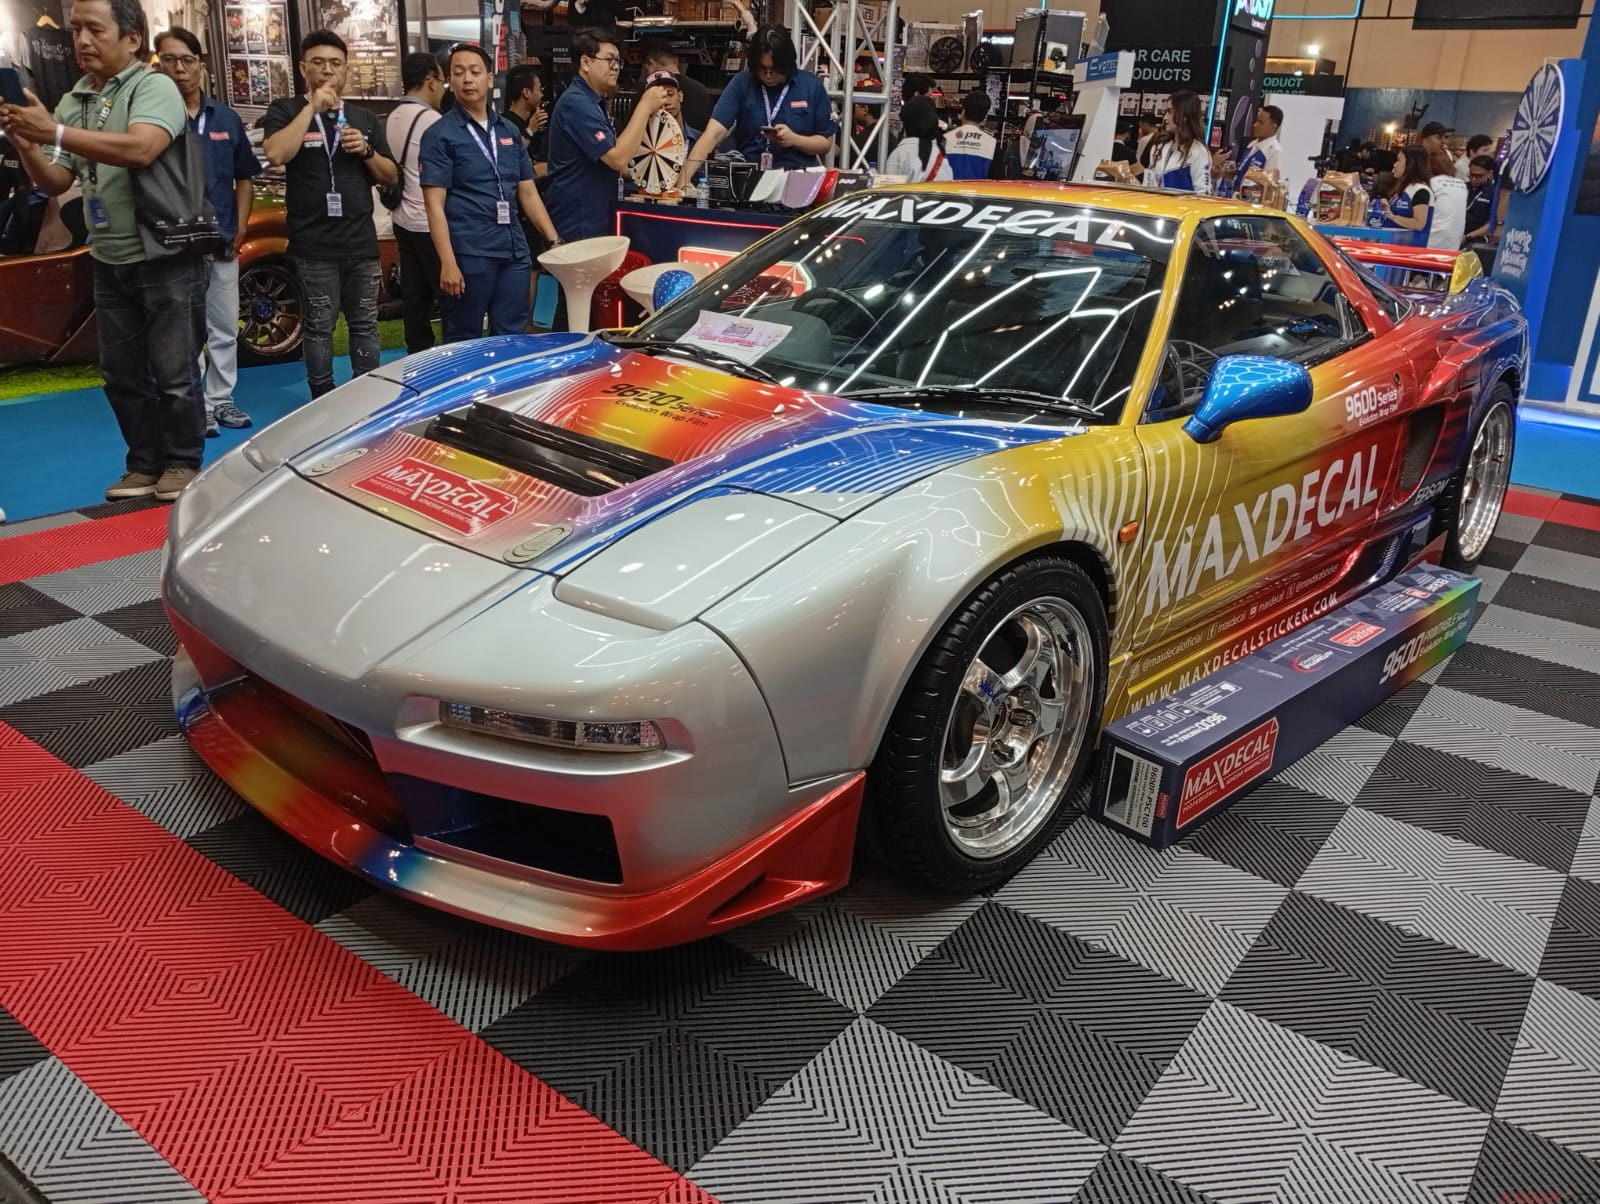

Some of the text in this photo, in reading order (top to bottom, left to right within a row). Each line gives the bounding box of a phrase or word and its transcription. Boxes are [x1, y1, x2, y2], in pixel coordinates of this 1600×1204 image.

[1132, 68, 1191, 81] ODUCTS
[1151, 50, 1191, 63] CARE
[1263, 77, 1303, 88] ODUCT
[811, 195, 1134, 250] MAXDECAL
[602, 383, 724, 420] 9600 Series
[614, 398, 709, 428] Evolution Wrap Film
[1345, 386, 1398, 422] 9600 Series
[380, 464, 501, 519] MAXDECAL
[1143, 445, 1378, 617] MAXDECAL
[1379, 631, 1426, 684] 9600
[1184, 731, 1271, 801] MAXDECAL
